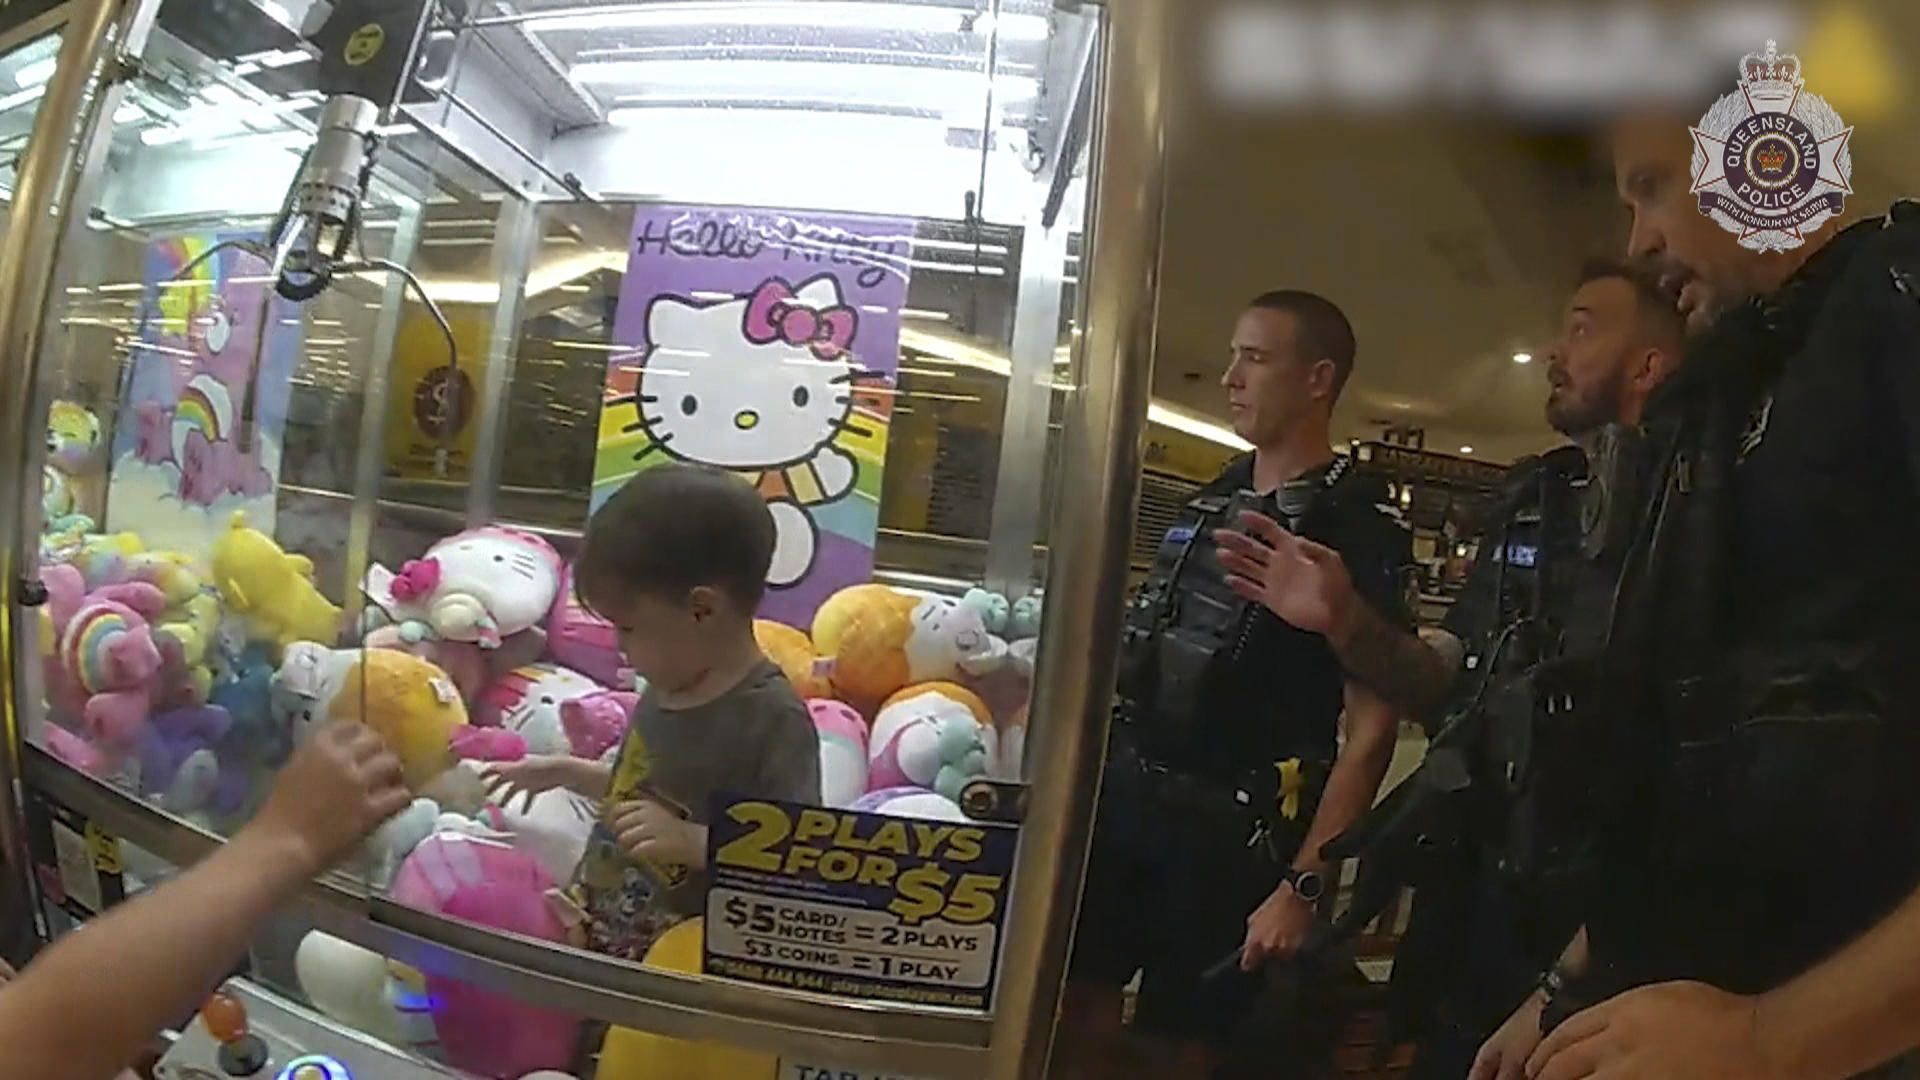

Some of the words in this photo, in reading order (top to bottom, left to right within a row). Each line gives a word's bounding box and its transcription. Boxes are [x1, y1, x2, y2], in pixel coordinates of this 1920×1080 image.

[637, 219, 761, 259] Hello
[715, 801, 792, 874] 2
[793, 808, 986, 863] PLAYS
[783, 845, 898, 887] FOR
[888, 862, 1004, 925] $5
[724, 896, 775, 933] $5
[779, 906, 848, 928] CARD/
[778, 924, 847, 945] NOTES
[880, 927, 899, 946] 2
[903, 931, 978, 952] PLAYS
[744, 939, 774, 959] $3
[777, 946, 840, 966] COINS
[878, 957, 892, 976] 1
[899, 962, 960, 981] PLAY
